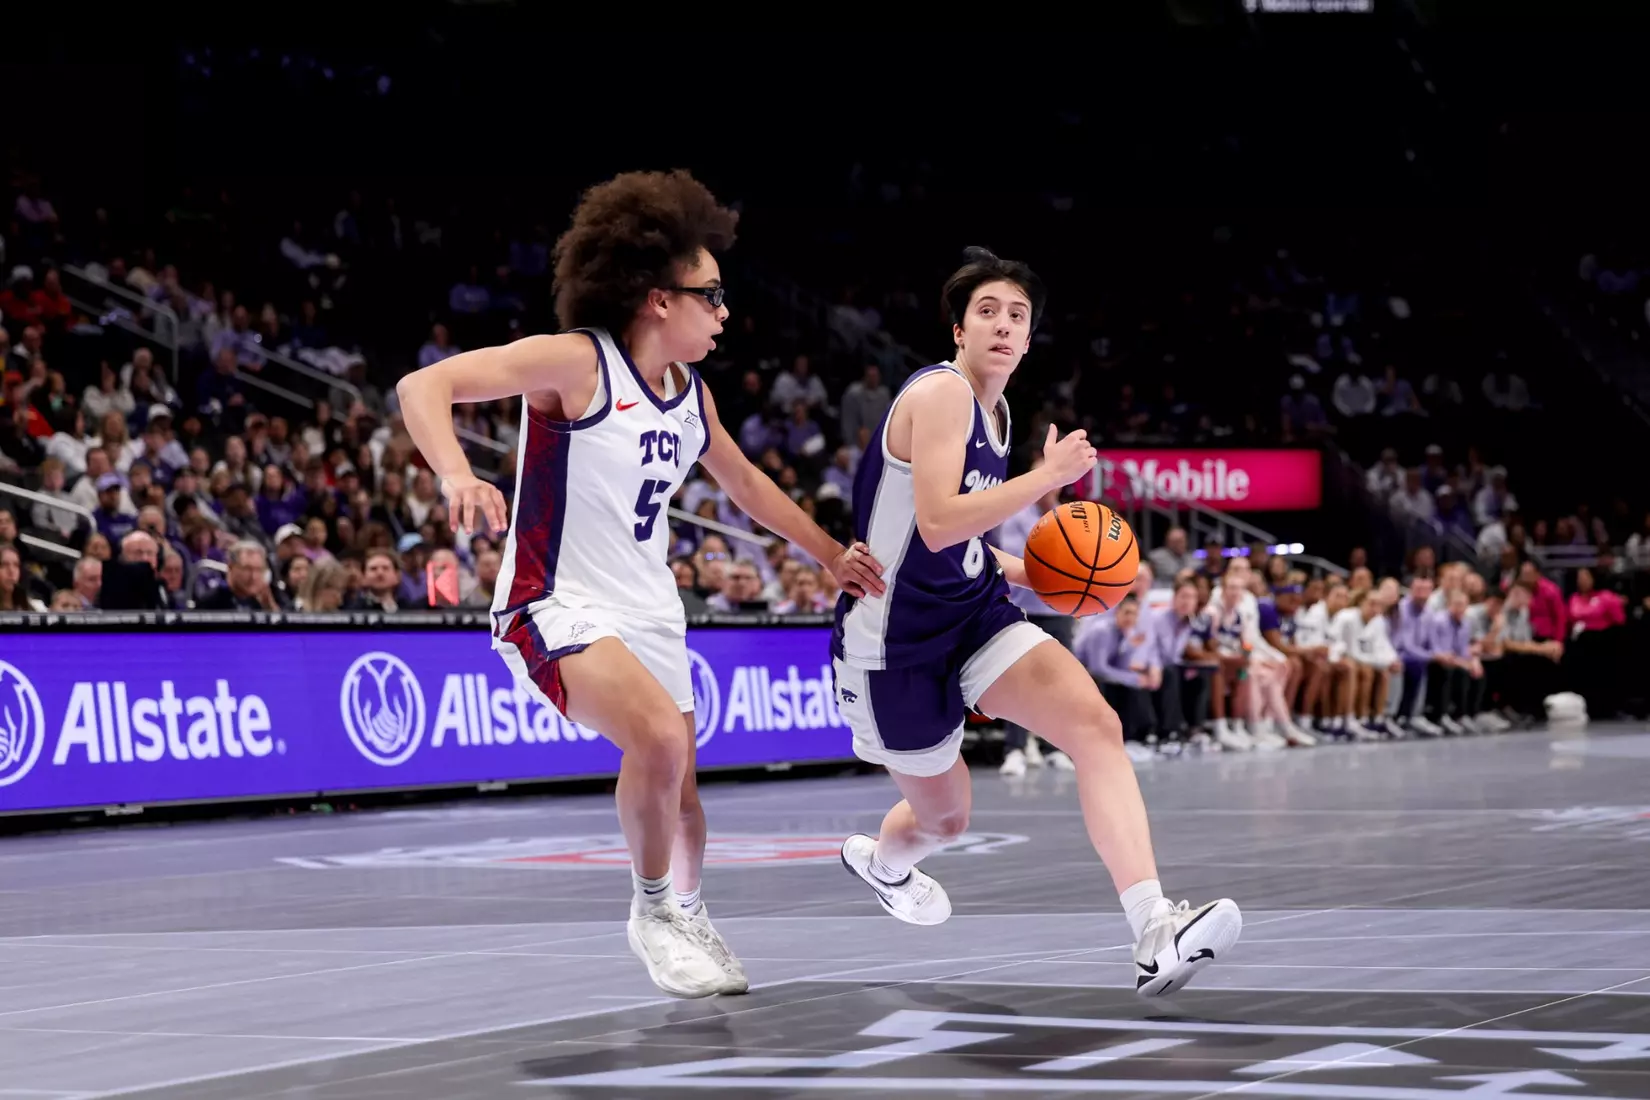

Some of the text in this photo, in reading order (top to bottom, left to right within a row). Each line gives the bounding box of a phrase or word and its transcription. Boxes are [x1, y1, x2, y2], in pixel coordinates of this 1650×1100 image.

[639, 429, 682, 468] TCU
[633, 478, 672, 542] 5
[53, 678, 274, 766] Allstate
[723, 664, 851, 734] Allstat
